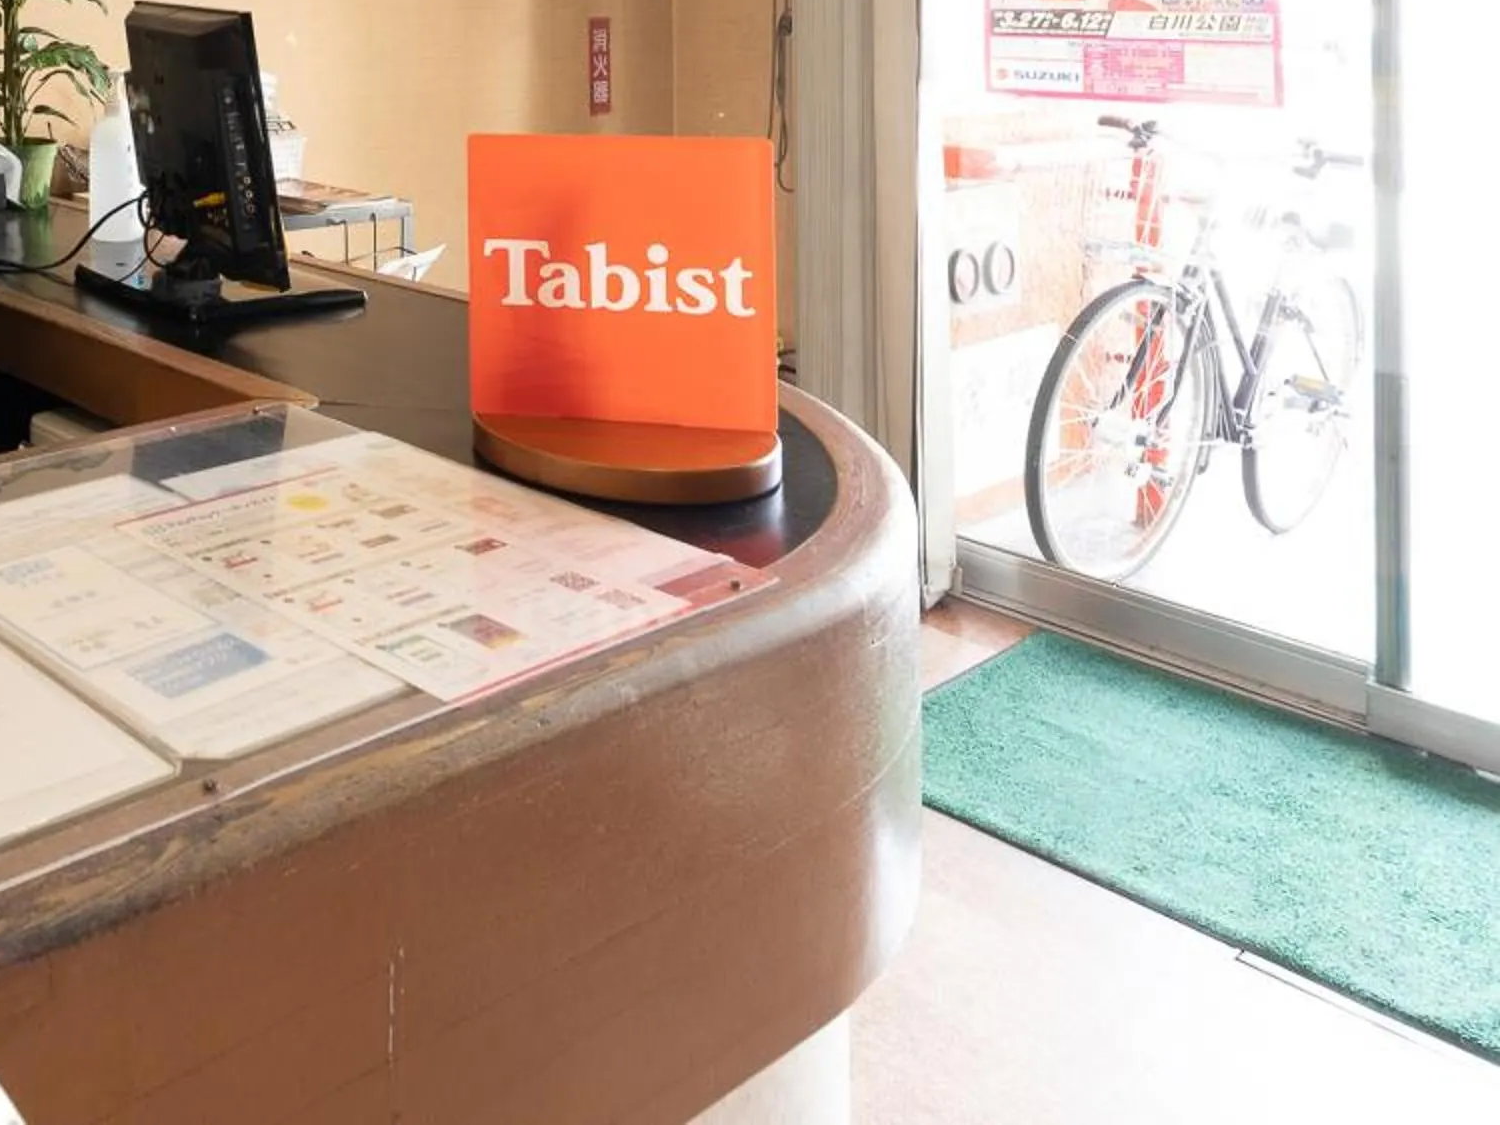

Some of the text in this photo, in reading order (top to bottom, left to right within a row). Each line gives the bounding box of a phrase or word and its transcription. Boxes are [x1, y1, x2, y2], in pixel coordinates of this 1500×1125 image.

[1149, 13, 1241, 32] 白川公園
[1012, 69, 1079, 83] SUZUKI
[484, 238, 756, 318] Tabist
